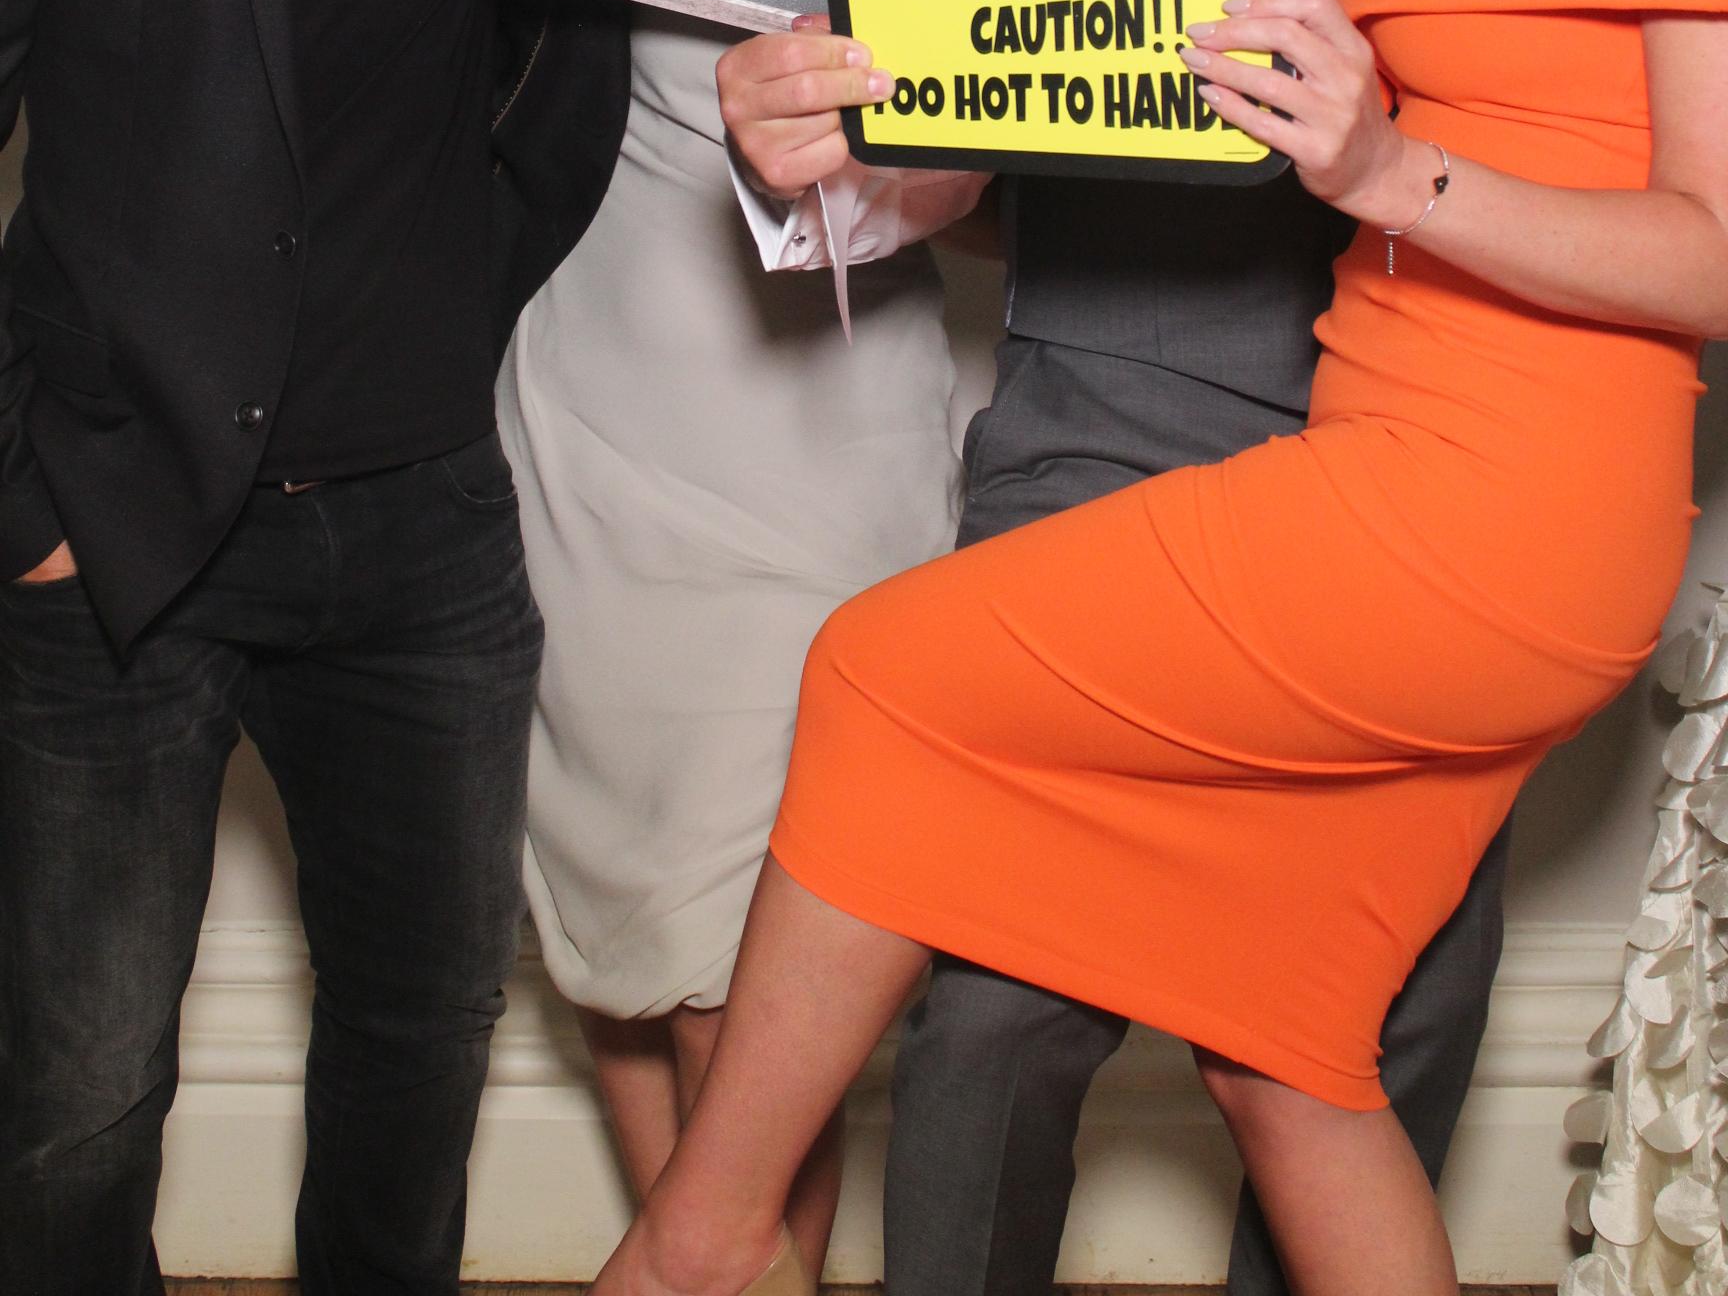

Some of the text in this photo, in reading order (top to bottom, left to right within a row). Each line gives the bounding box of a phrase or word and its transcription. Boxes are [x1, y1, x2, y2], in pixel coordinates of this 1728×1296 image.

[873, 76, 945, 117] OO
[954, 74, 1033, 122] HOT
[1041, 73, 1094, 124] TO
